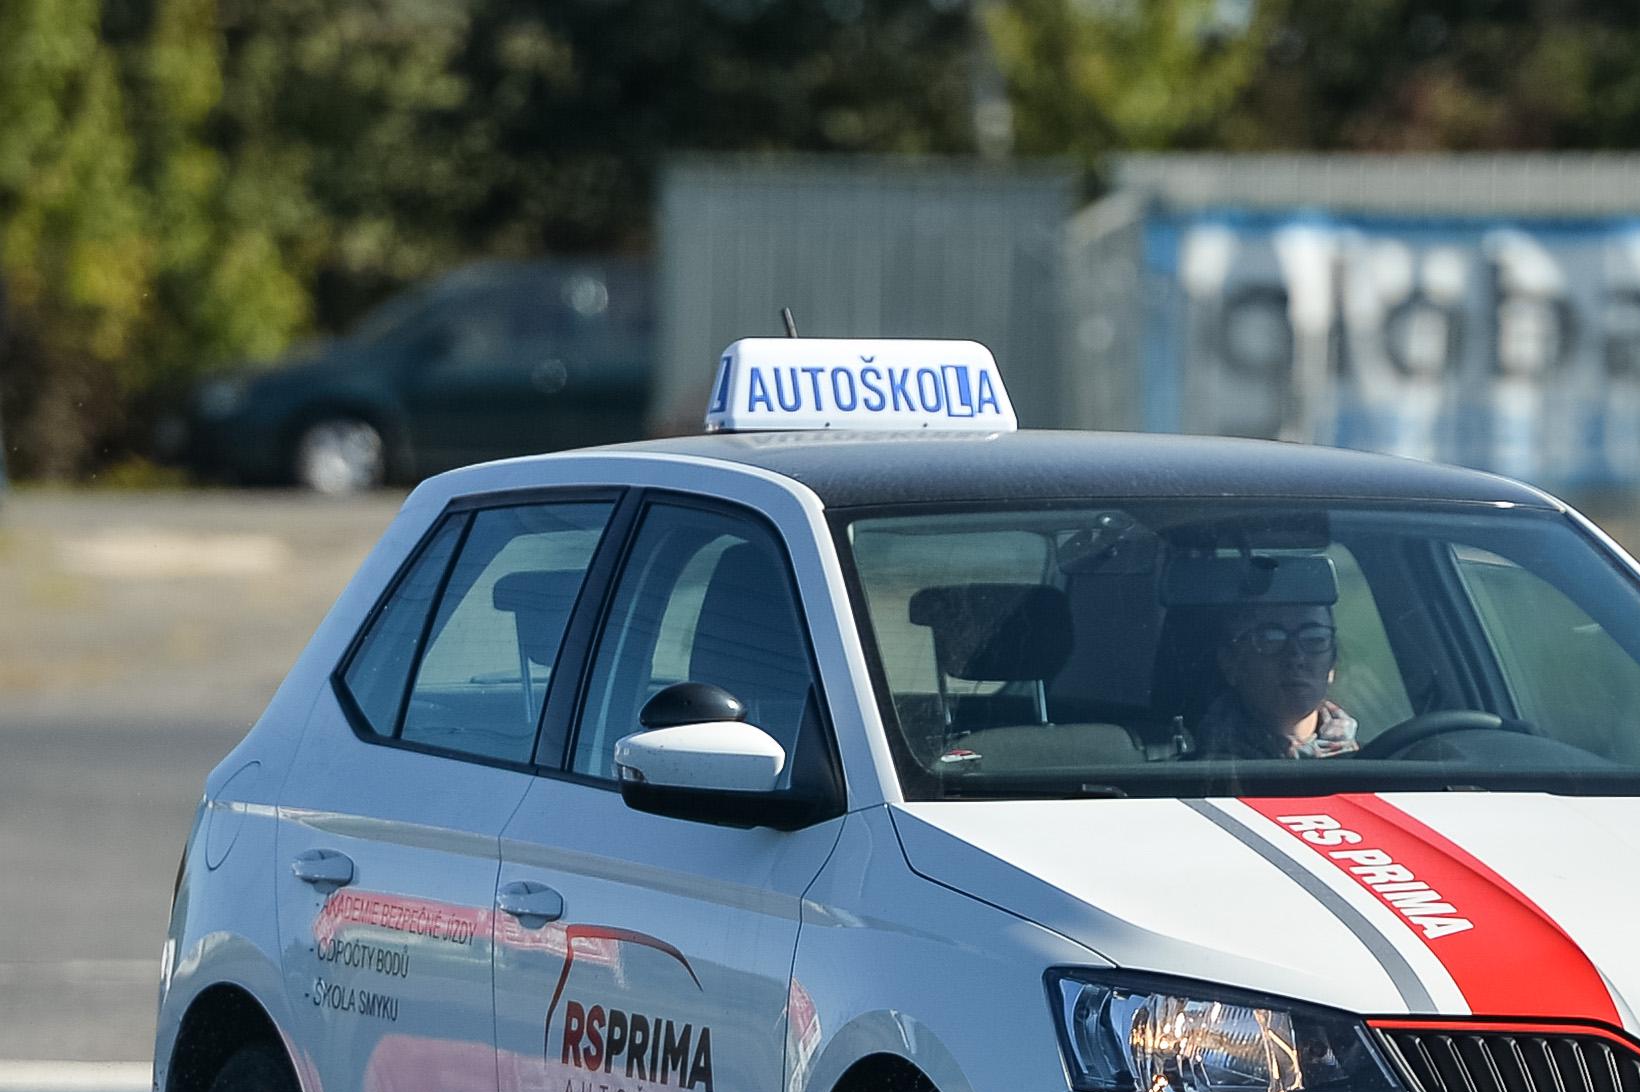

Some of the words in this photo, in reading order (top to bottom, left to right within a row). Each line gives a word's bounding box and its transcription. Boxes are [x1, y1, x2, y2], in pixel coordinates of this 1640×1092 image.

[747, 355, 1002, 418] AUTOŠKOLA
[1275, 812, 1363, 847] RS
[1327, 847, 1475, 941] PRIMA
[380, 903, 443, 940] BEZPEČNÉ
[443, 912, 478, 946] JÍZDY
[376, 944, 410, 979] BODŮ
[312, 976, 357, 1013] ŠKOLA
[358, 989, 400, 1022] SMYKU
